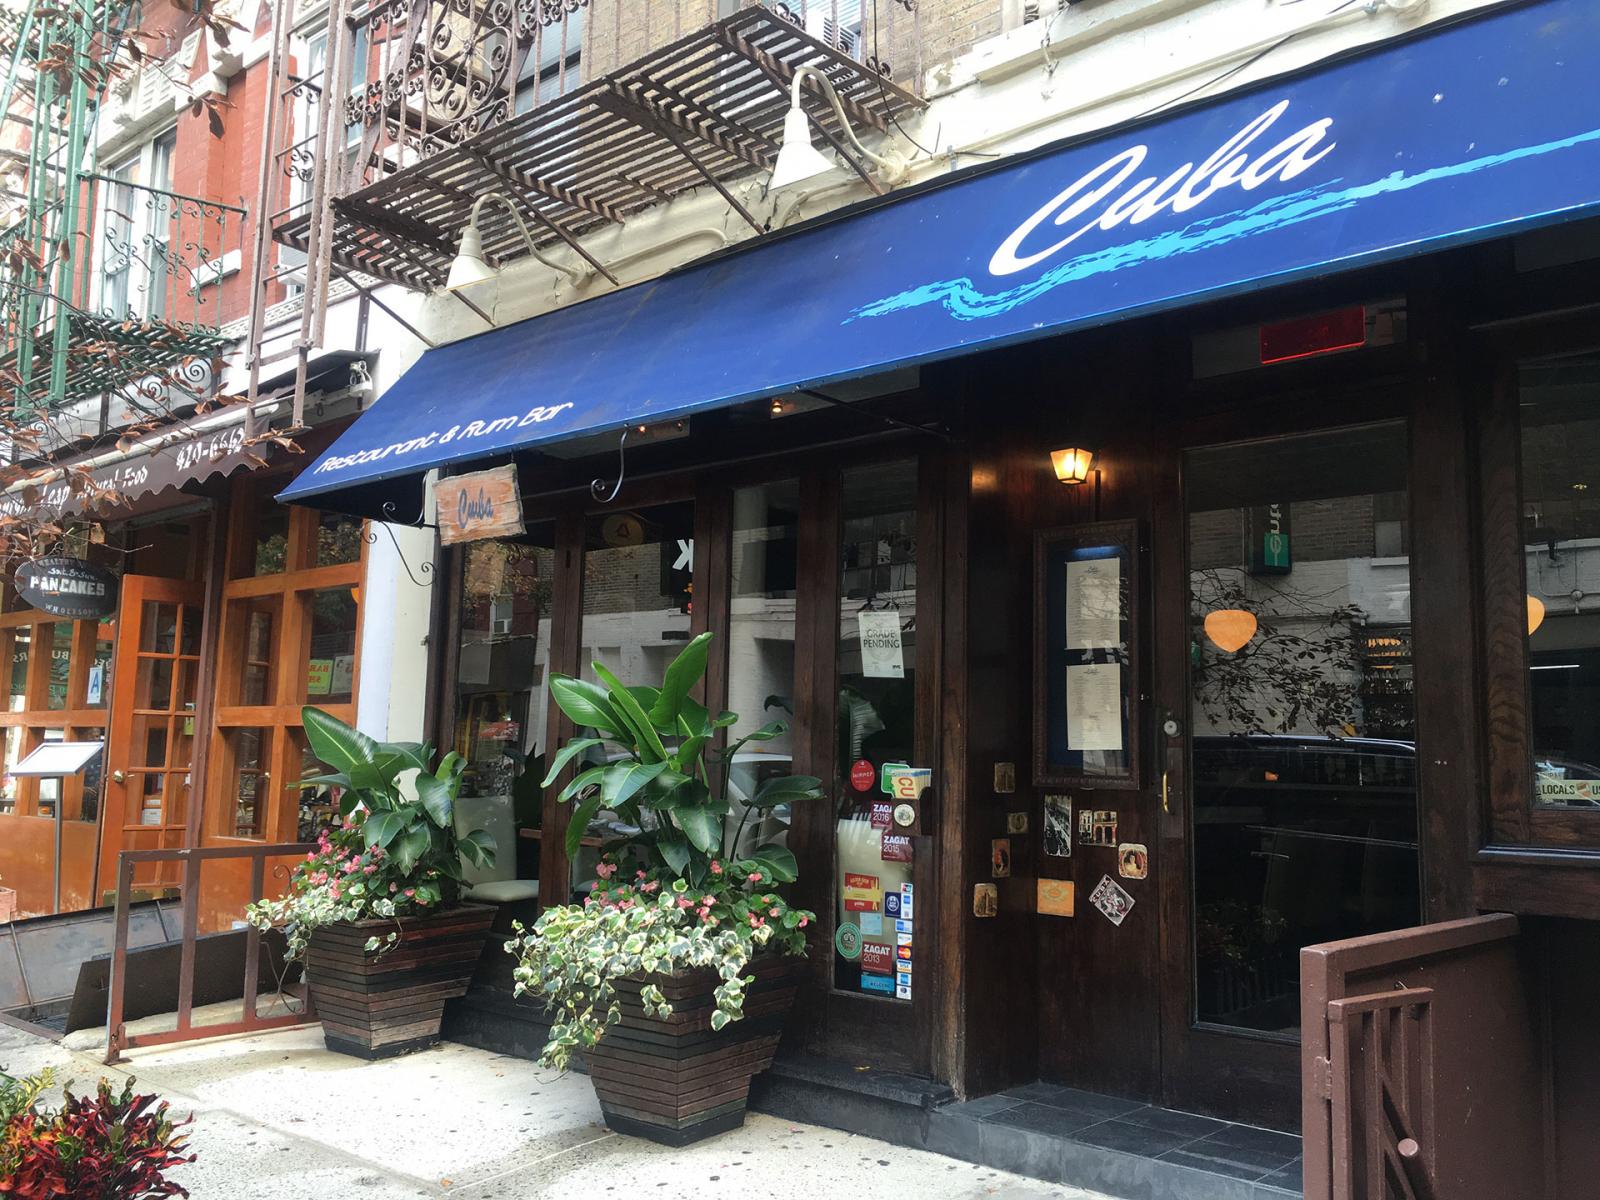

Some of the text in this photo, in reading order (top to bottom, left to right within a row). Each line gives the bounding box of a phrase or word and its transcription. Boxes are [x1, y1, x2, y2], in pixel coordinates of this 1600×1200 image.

[988, 99, 1336, 276] Cuba
[313, 402, 573, 475] Restaurant & Rum Bar
[457, 488, 494, 529] Cuba
[30, 576, 105, 596] PANCAKES
[866, 628, 896, 639] GRADE
[863, 639, 900, 649] PENDING
[90, 672, 100, 694] A
[1542, 784, 1575, 795] LOCALS
[873, 812, 890, 822] 2016
[883, 835, 910, 845] ZAGAT
[883, 844, 900, 853] 2015
[863, 943, 890, 956] ZAGAT
[863, 953, 880, 964] 2013
